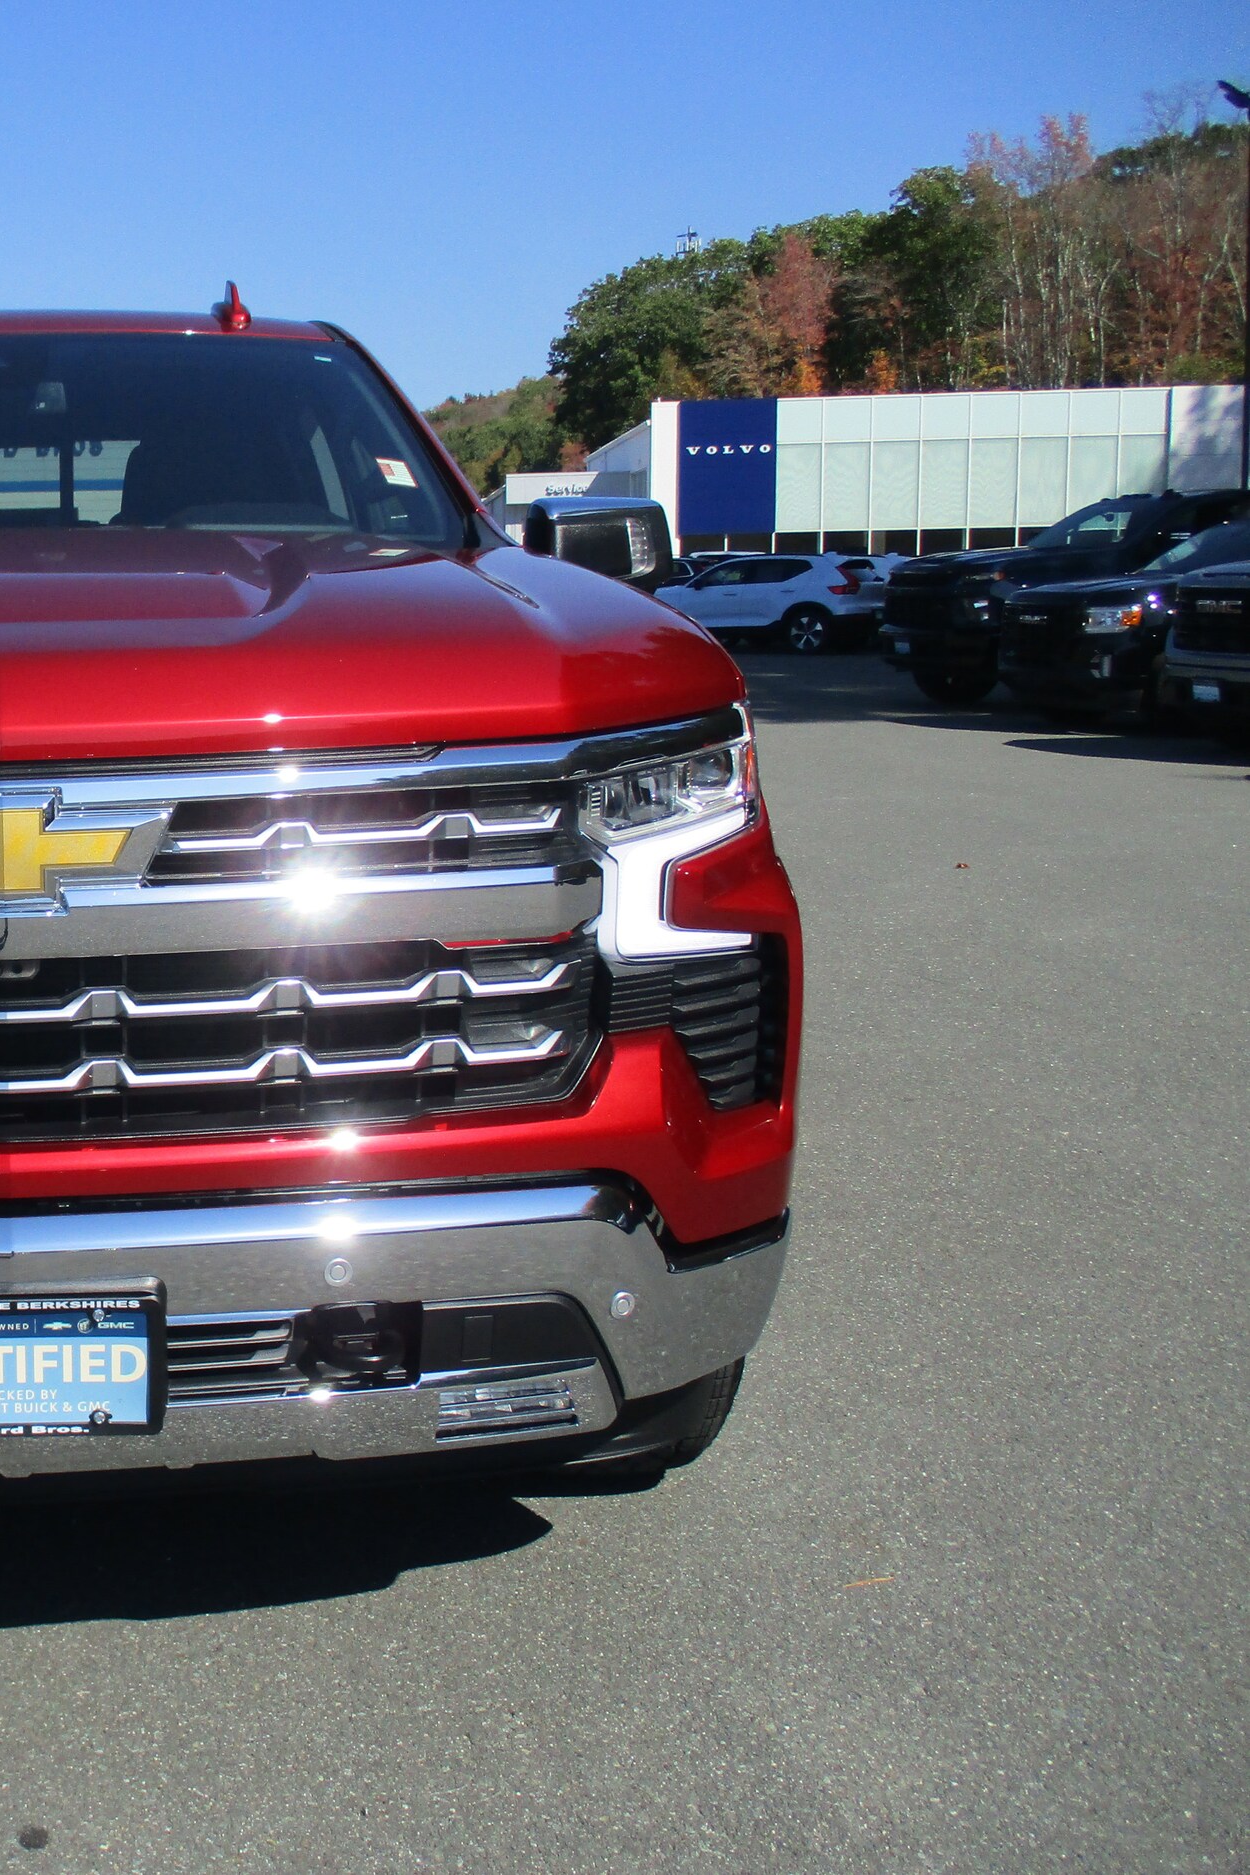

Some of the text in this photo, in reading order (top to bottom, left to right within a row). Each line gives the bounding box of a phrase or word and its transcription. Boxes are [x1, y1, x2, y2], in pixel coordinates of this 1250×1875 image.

[686, 444, 771, 455] VOLVO
[16, 1300, 141, 1310] BERKSHIRES
[97, 1321, 135, 1329] GMC
[40, 1389, 58, 1400] BY
[14, 1402, 58, 1413] BUICK
[62, 1402, 73, 1413] &
[77, 1401, 111, 1412] GMC
[31, 1425, 90, 1435] Bros.
